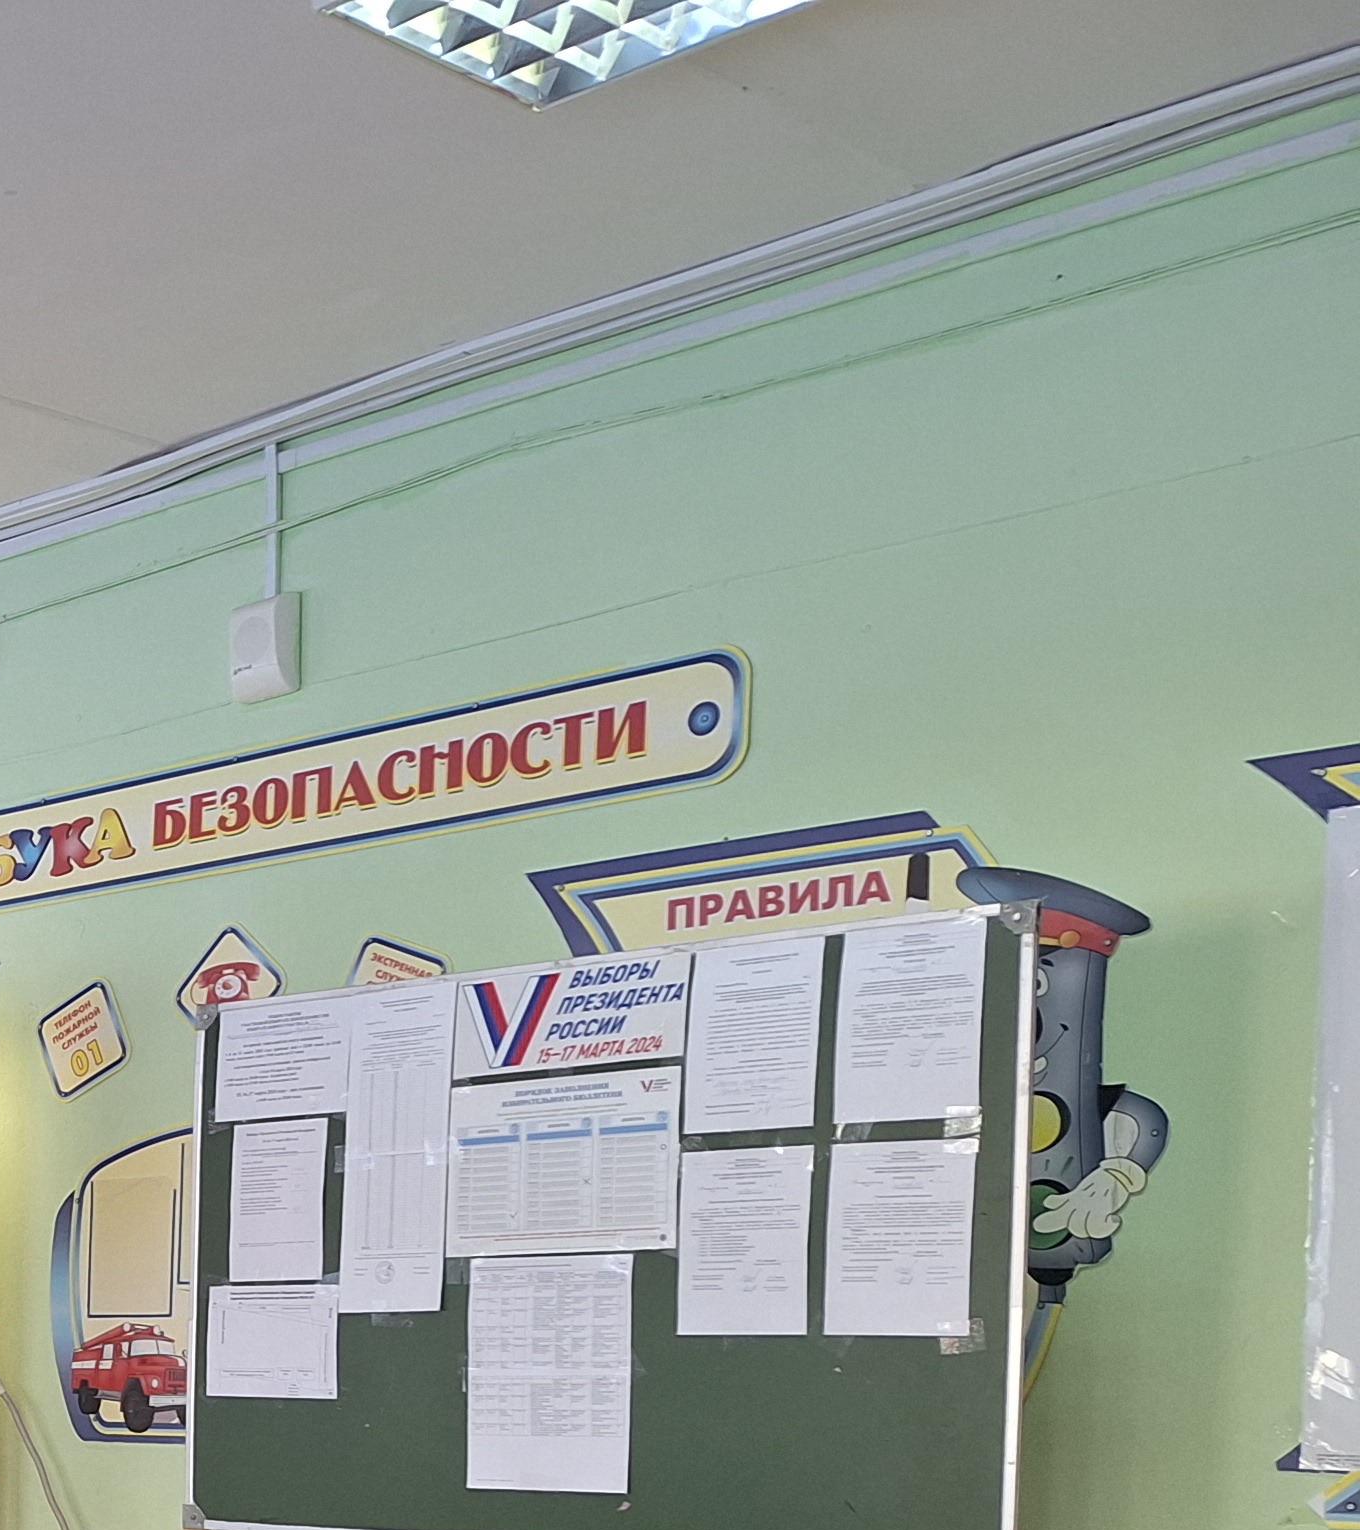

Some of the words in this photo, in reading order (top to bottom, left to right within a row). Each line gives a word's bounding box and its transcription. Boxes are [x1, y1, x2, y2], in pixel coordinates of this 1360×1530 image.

[152, 700, 648, 850] БЕЗОПАСНОСТИ
[666, 870, 892, 931] ПРАВИЛА
[568, 959, 661, 989] ВЫБОРЫ
[555, 982, 686, 1015] ПРЕЗИДЕНТА
[51, 1006, 101, 1045] ПОЖАРНОЙ
[53, 1000, 92, 1030] ТЕЛЕФОН
[544, 1014, 628, 1042] РОССИИ
[61, 1021, 98, 1050] СЛУЖБЫ
[577, 1040, 625, 1061] МАРТА
[625, 1034, 664, 1056] 2024
[70, 1038, 104, 1078] 01
